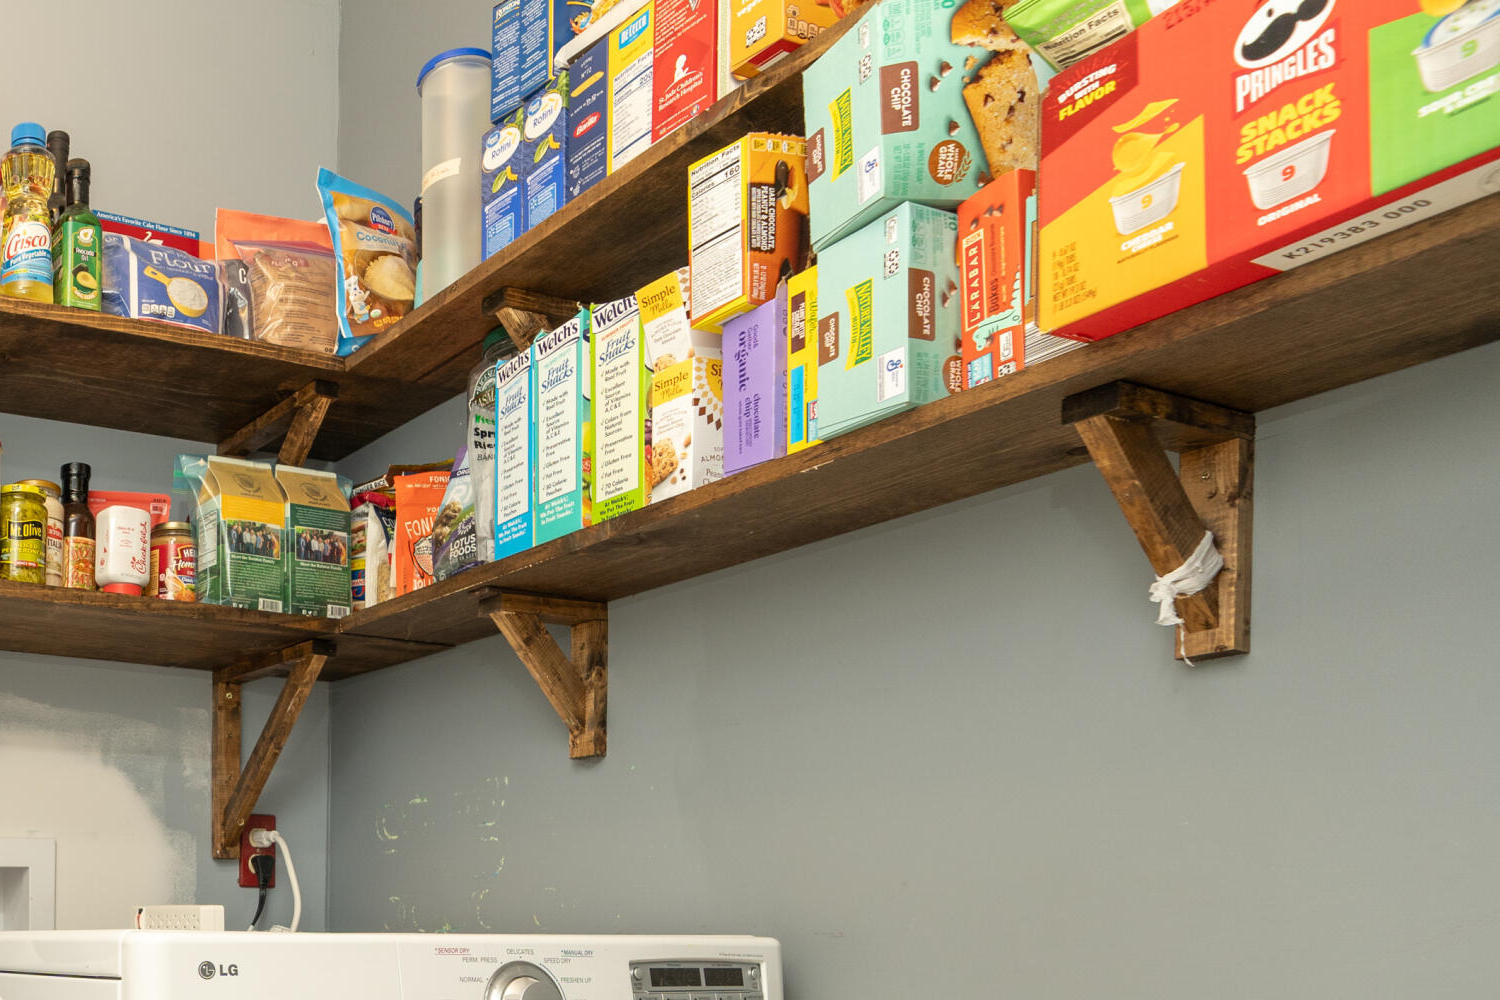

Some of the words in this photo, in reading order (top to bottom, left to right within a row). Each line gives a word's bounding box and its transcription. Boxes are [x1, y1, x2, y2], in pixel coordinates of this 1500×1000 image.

[1088, 8, 1120, 31] Facts
[1056, 63, 1118, 105] BURSTING
[1235, 27, 1336, 114] PRINGLES
[891, 87, 901, 110] CHIP
[900, 67, 912, 128] CHOCOLATE
[1058, 80, 1118, 122] FLAVOR
[532, 106, 555, 129] Rotini
[1239, 81, 1337, 145] SNACK
[1235, 99, 1342, 165] STACKS
[491, 140, 513, 161] Rotini
[690, 155, 720, 177] Nutrition
[721, 143, 740, 158] Facts
[937, 146, 947, 179] GRAIN
[944, 143, 956, 181] WHOLE
[724, 164, 740, 180] 160
[96, 210, 122, 223] America's
[122, 216, 142, 228] Favorite
[143, 220, 155, 230] Cake
[155, 223, 169, 233] Flour
[1256, 192, 1323, 227] ORIGINAL
[6, 233, 48, 260] Crisco
[1120, 221, 1175, 252] CHEDDAR
[641, 284, 676, 309] Simple
[856, 284, 873, 324] NATURE
[915, 293, 923, 316] CHIP
[922, 276, 931, 336] CHOCOLATE
[989, 277, 999, 313] Bakes
[537, 322, 578, 356] Welch's
[598, 337, 636, 366] Snacks
[606, 329, 631, 353] Fruit
[856, 323, 873, 360] VALLEY
[547, 358, 570, 378] Fruit
[734, 331, 750, 393] organic
[541, 367, 575, 395] Snacks
[654, 370, 689, 393] Simple
[744, 397, 753, 418] chip
[753, 393, 764, 439] chocolate
[10, 522, 22, 538] Mt.
[22, 522, 43, 538] Olive
[450, 533, 477, 551] LOTUS
[449, 543, 477, 560] FOODS
[480, 956, 498, 964] PRESS
[506, 948, 535, 956] DELICATES
[219, 964, 239, 977] LG
